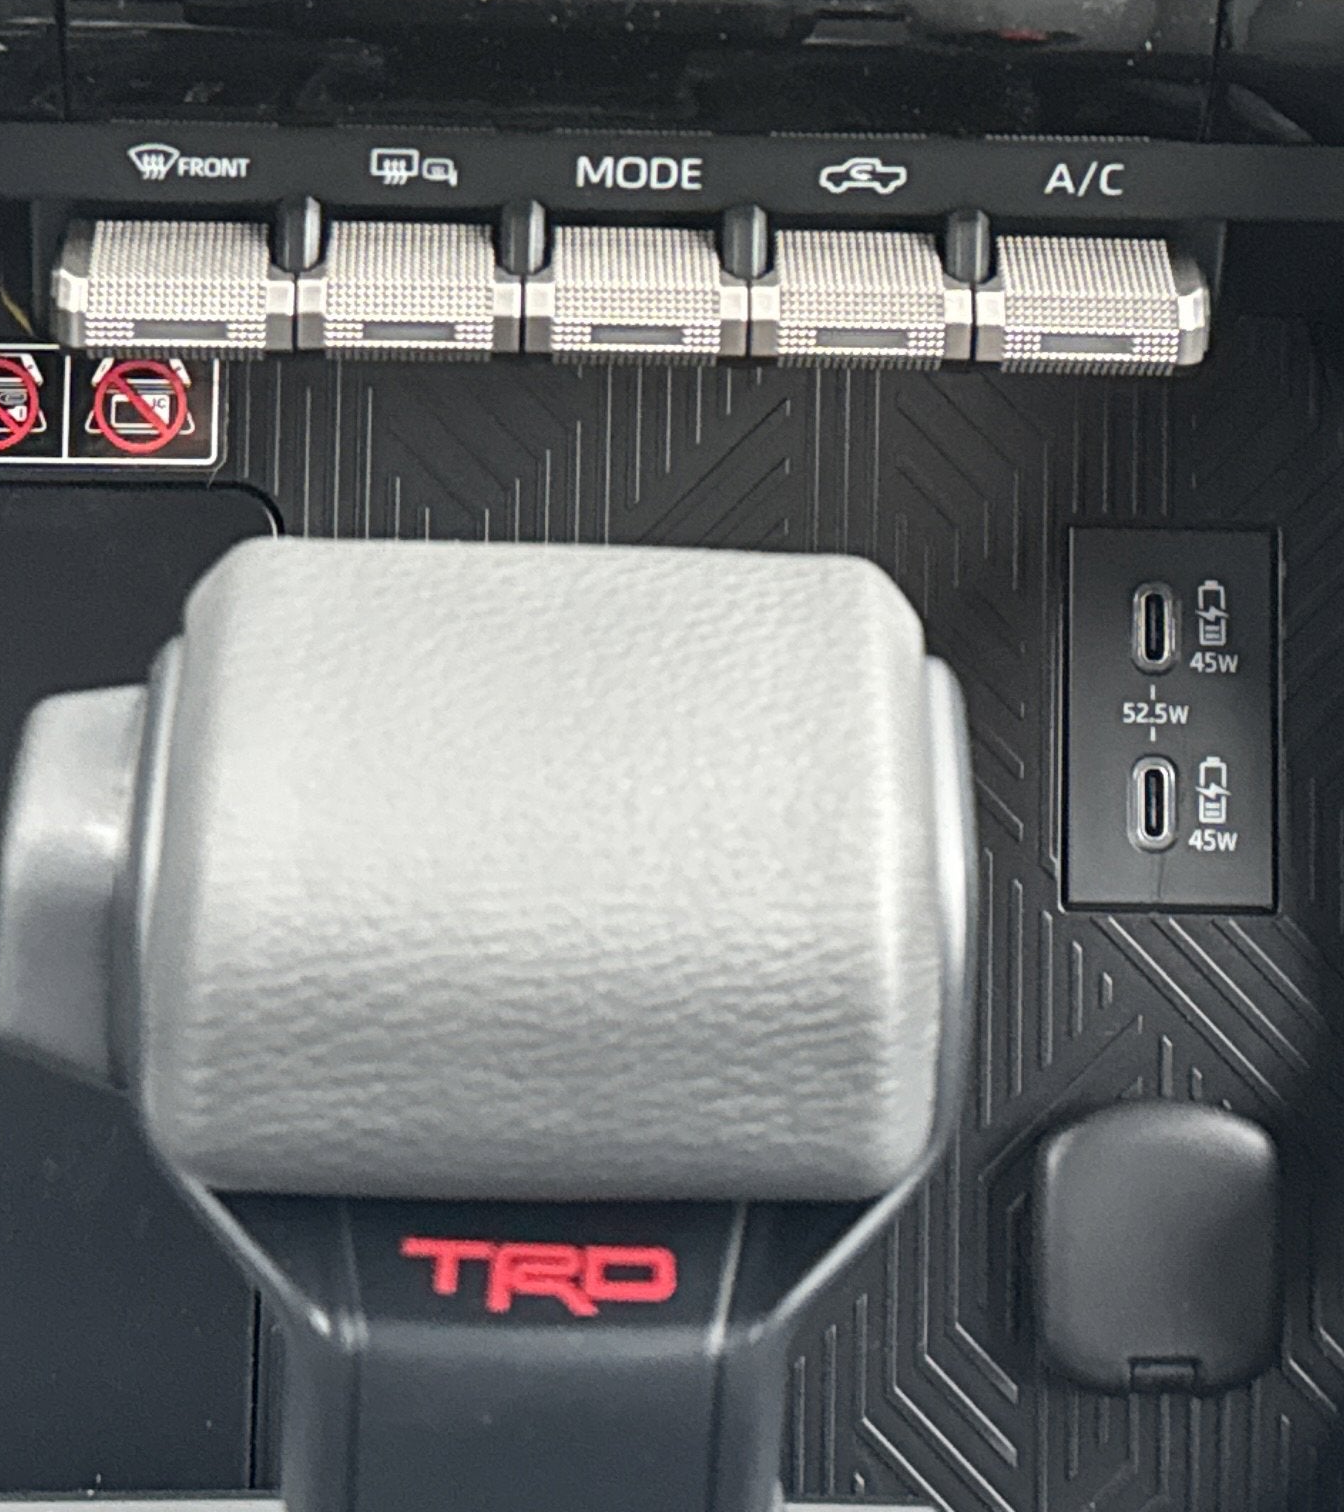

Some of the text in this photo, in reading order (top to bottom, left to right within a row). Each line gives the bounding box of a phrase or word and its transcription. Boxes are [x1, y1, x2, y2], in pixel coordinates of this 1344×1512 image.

[177, 156, 251, 179] FRONT
[575, 155, 704, 190] MODE
[1043, 161, 1125, 197] A/C
[1189, 651, 1238, 674] 45W
[1122, 703, 1189, 725] 52.5W
[1188, 830, 1237, 852] 45W
[400, 1235, 677, 1317] TRD
